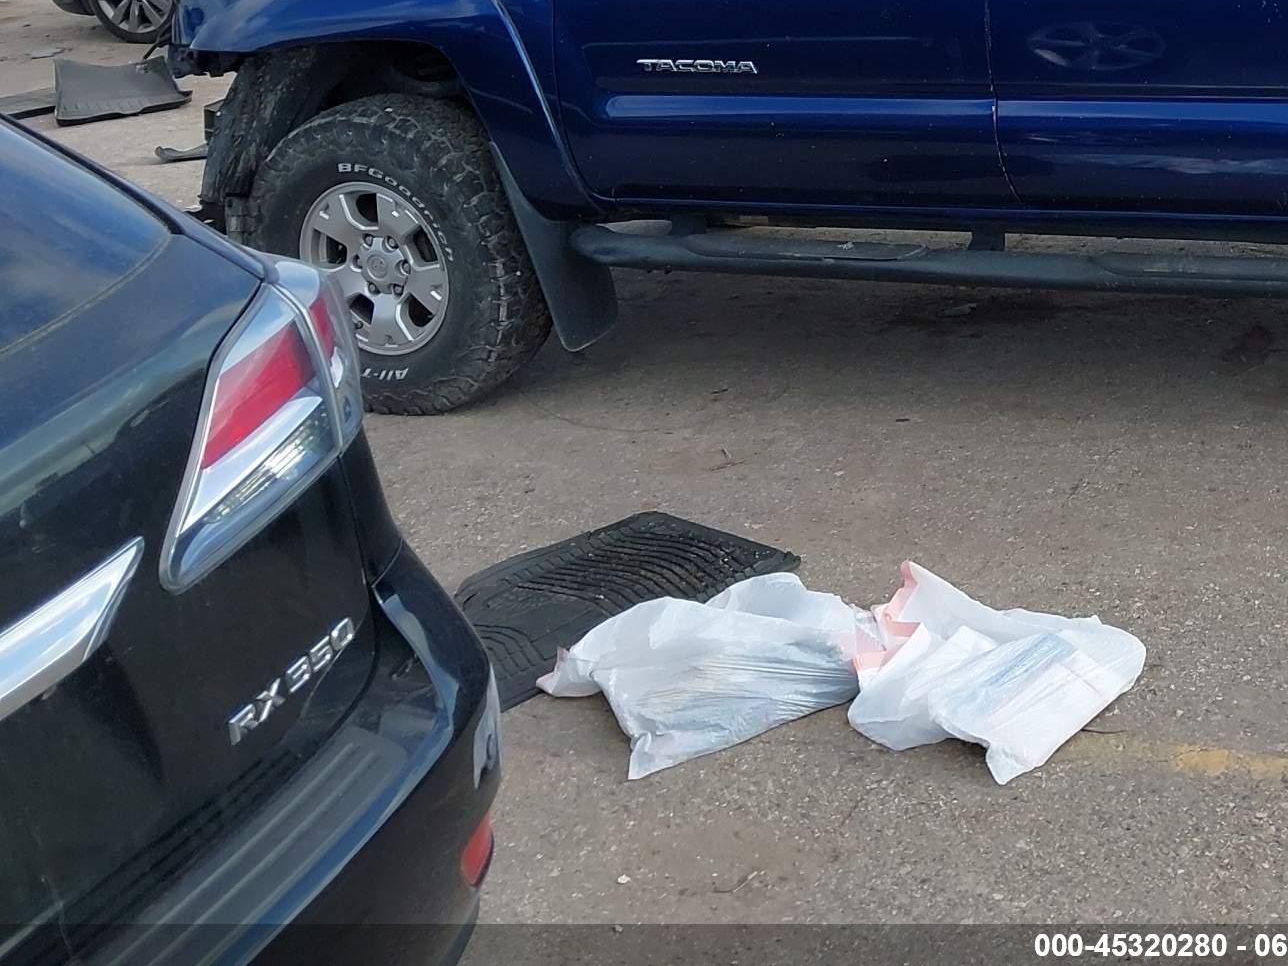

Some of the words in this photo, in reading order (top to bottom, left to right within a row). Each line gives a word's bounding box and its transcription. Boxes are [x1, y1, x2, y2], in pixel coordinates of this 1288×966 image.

[636, 59, 758, 74] TACOMA
[228, 678, 286, 746] RX
[285, 617, 355, 694] 350
